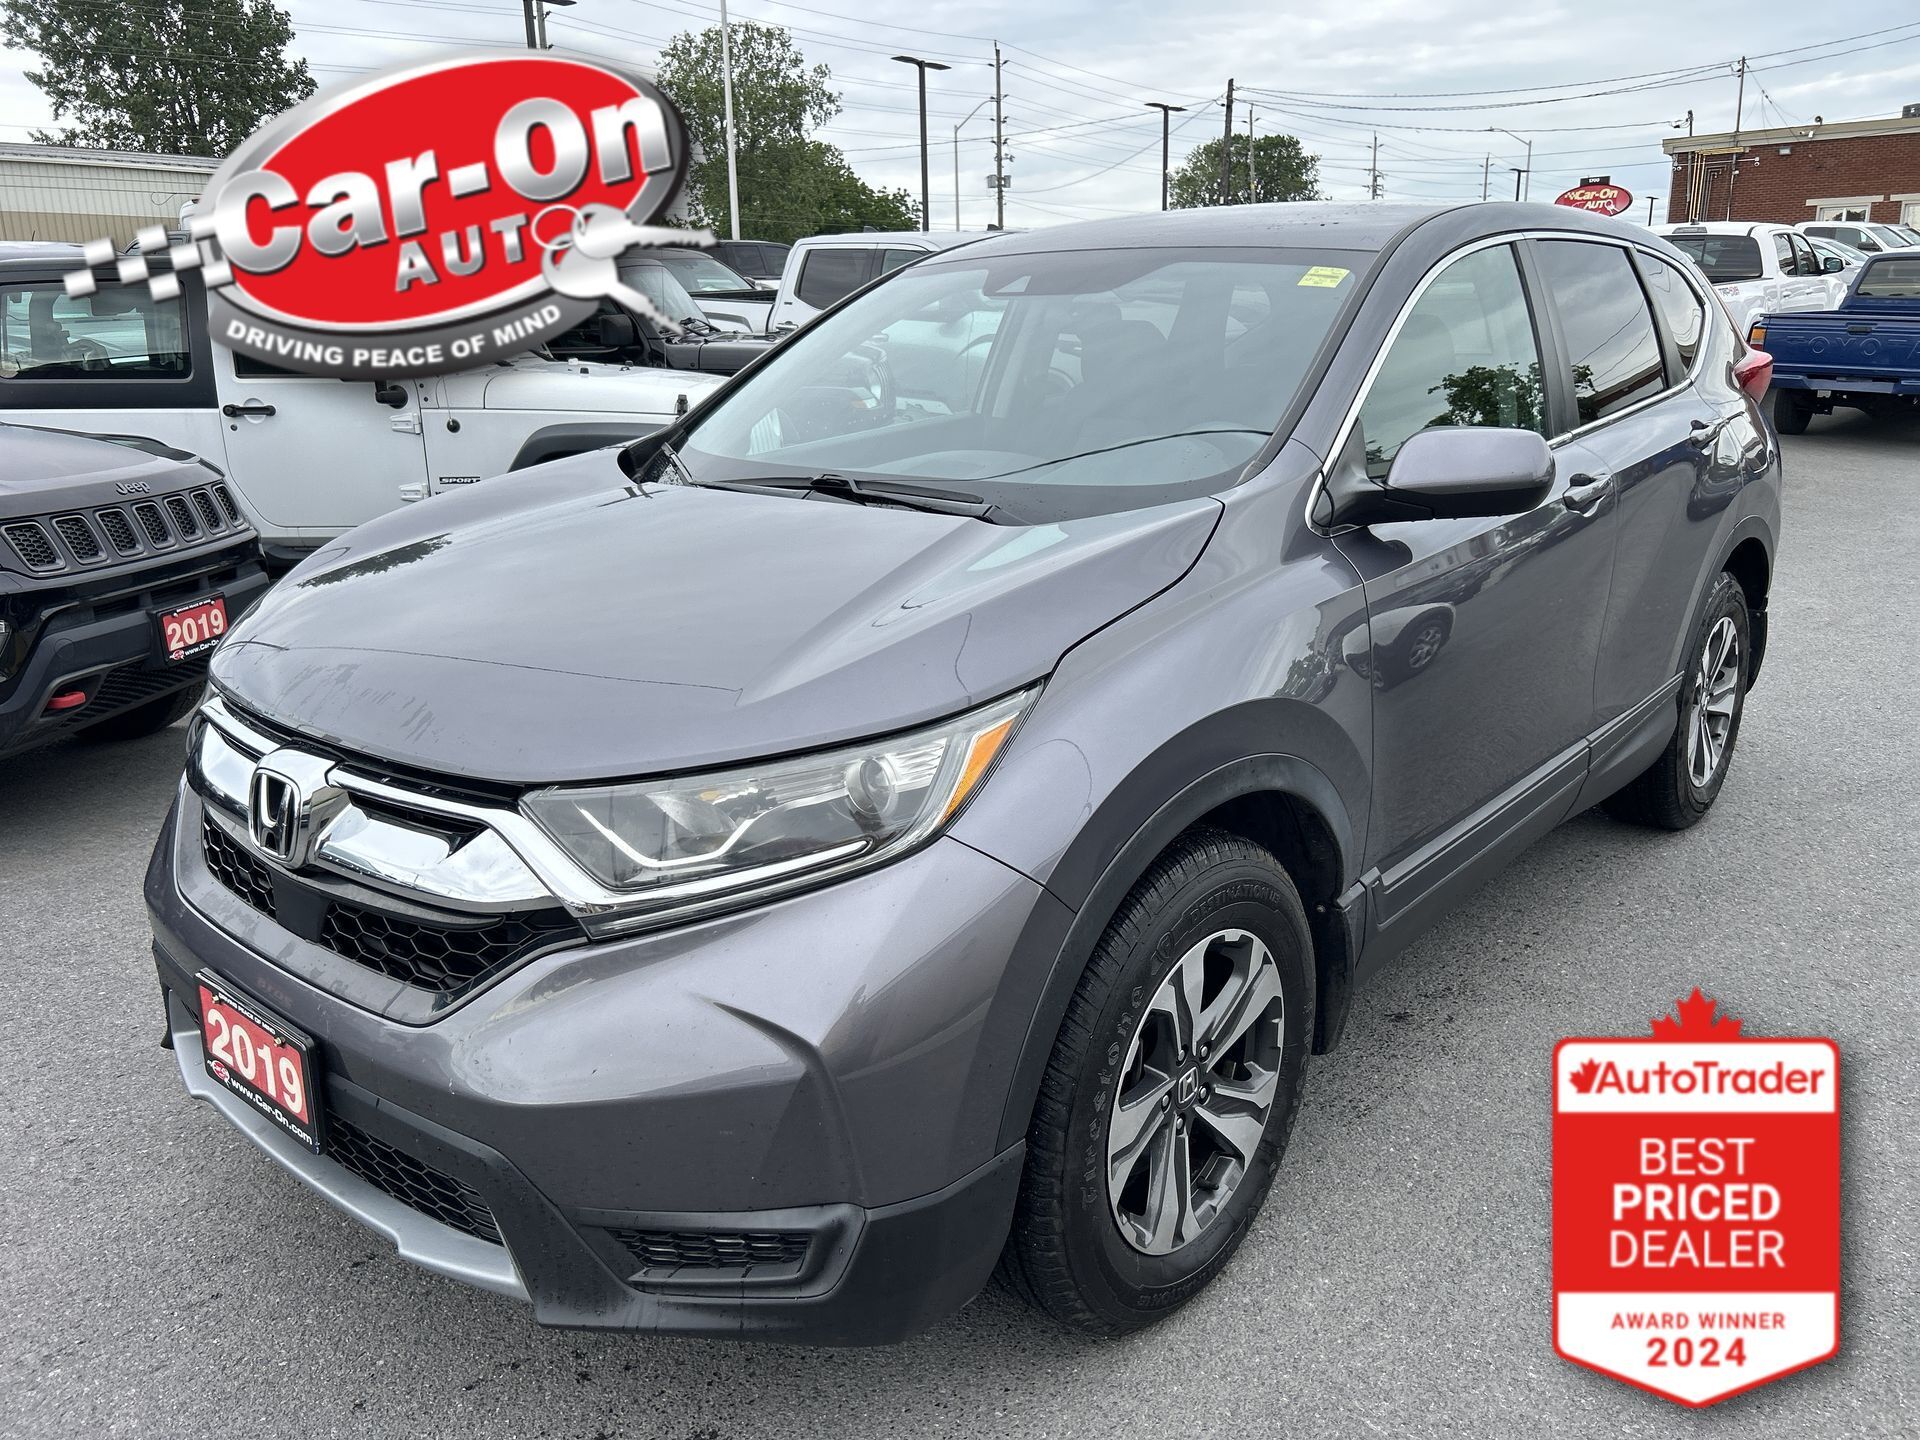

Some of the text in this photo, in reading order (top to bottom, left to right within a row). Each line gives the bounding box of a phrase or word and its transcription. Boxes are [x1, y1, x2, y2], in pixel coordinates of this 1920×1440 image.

[1577, 188, 1618, 200] Car-On
[115, 481, 150, 495] Jeep
[167, 608, 224, 652] 2019
[207, 1008, 303, 1114] 2019
[231, 1077, 313, 1146] www.Car-On.com
